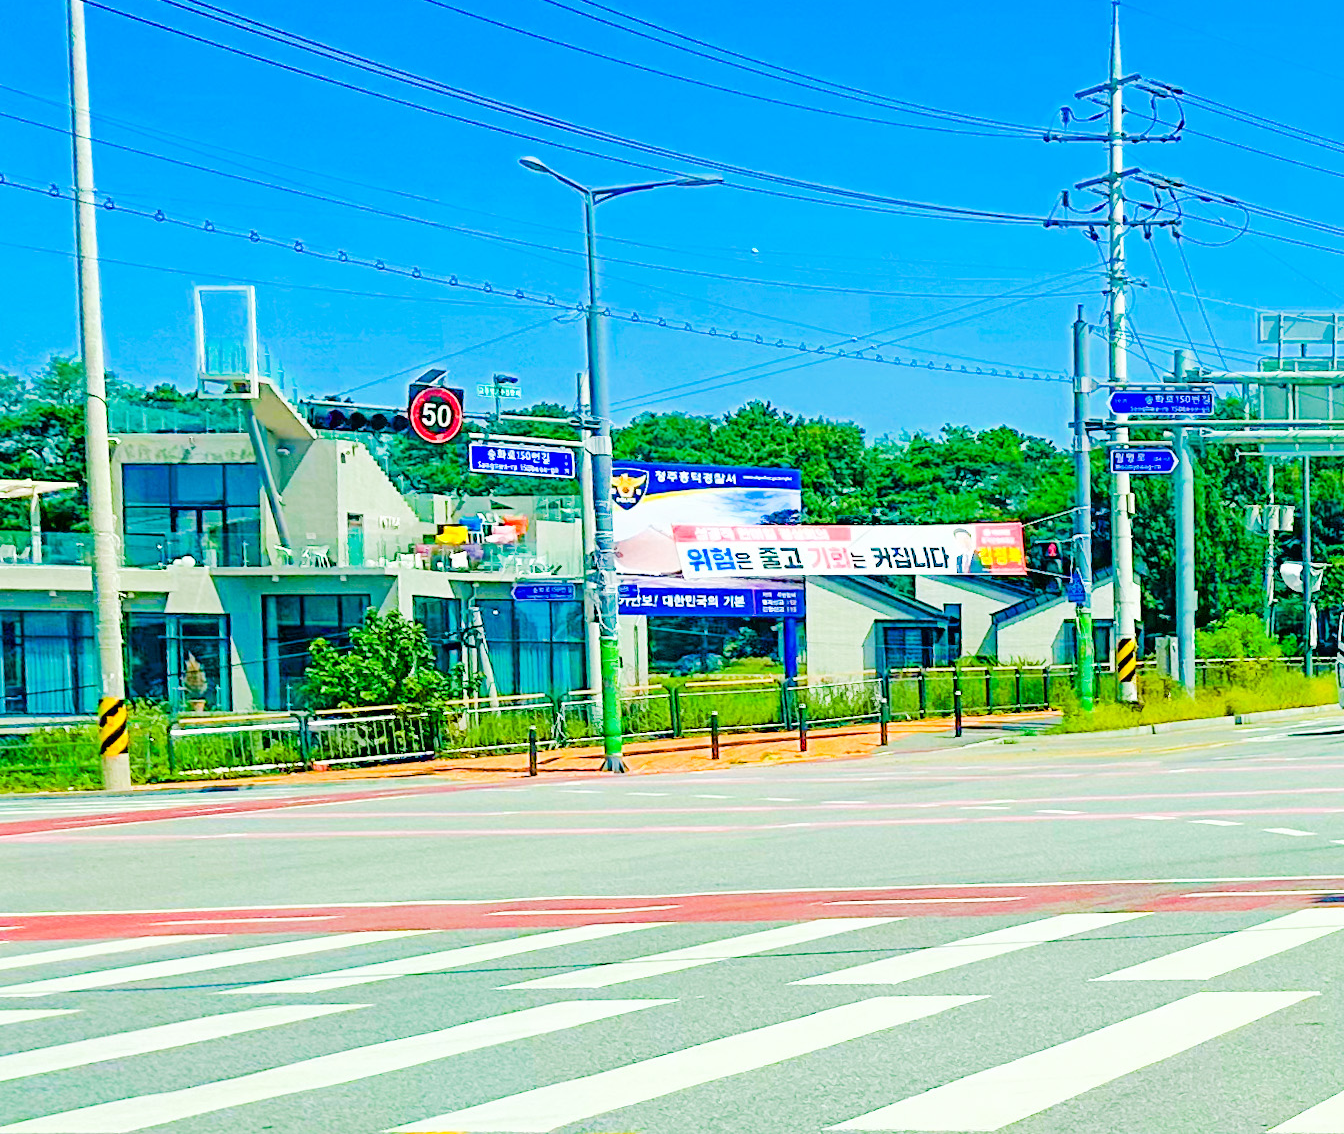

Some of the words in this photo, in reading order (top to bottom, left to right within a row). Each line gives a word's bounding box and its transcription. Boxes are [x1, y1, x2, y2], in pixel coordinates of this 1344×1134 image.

[421, 403, 452, 428] 50
[654, 470, 737, 485] 청주흥덕경찰서
[687, 547, 754, 571] 위험은
[758, 547, 804, 569] 줄고
[807, 547, 868, 569] 기회는
[870, 546, 950, 569] 커집니다
[661, 594, 719, 608] 대한민국의
[723, 595, 746, 608] 기본
